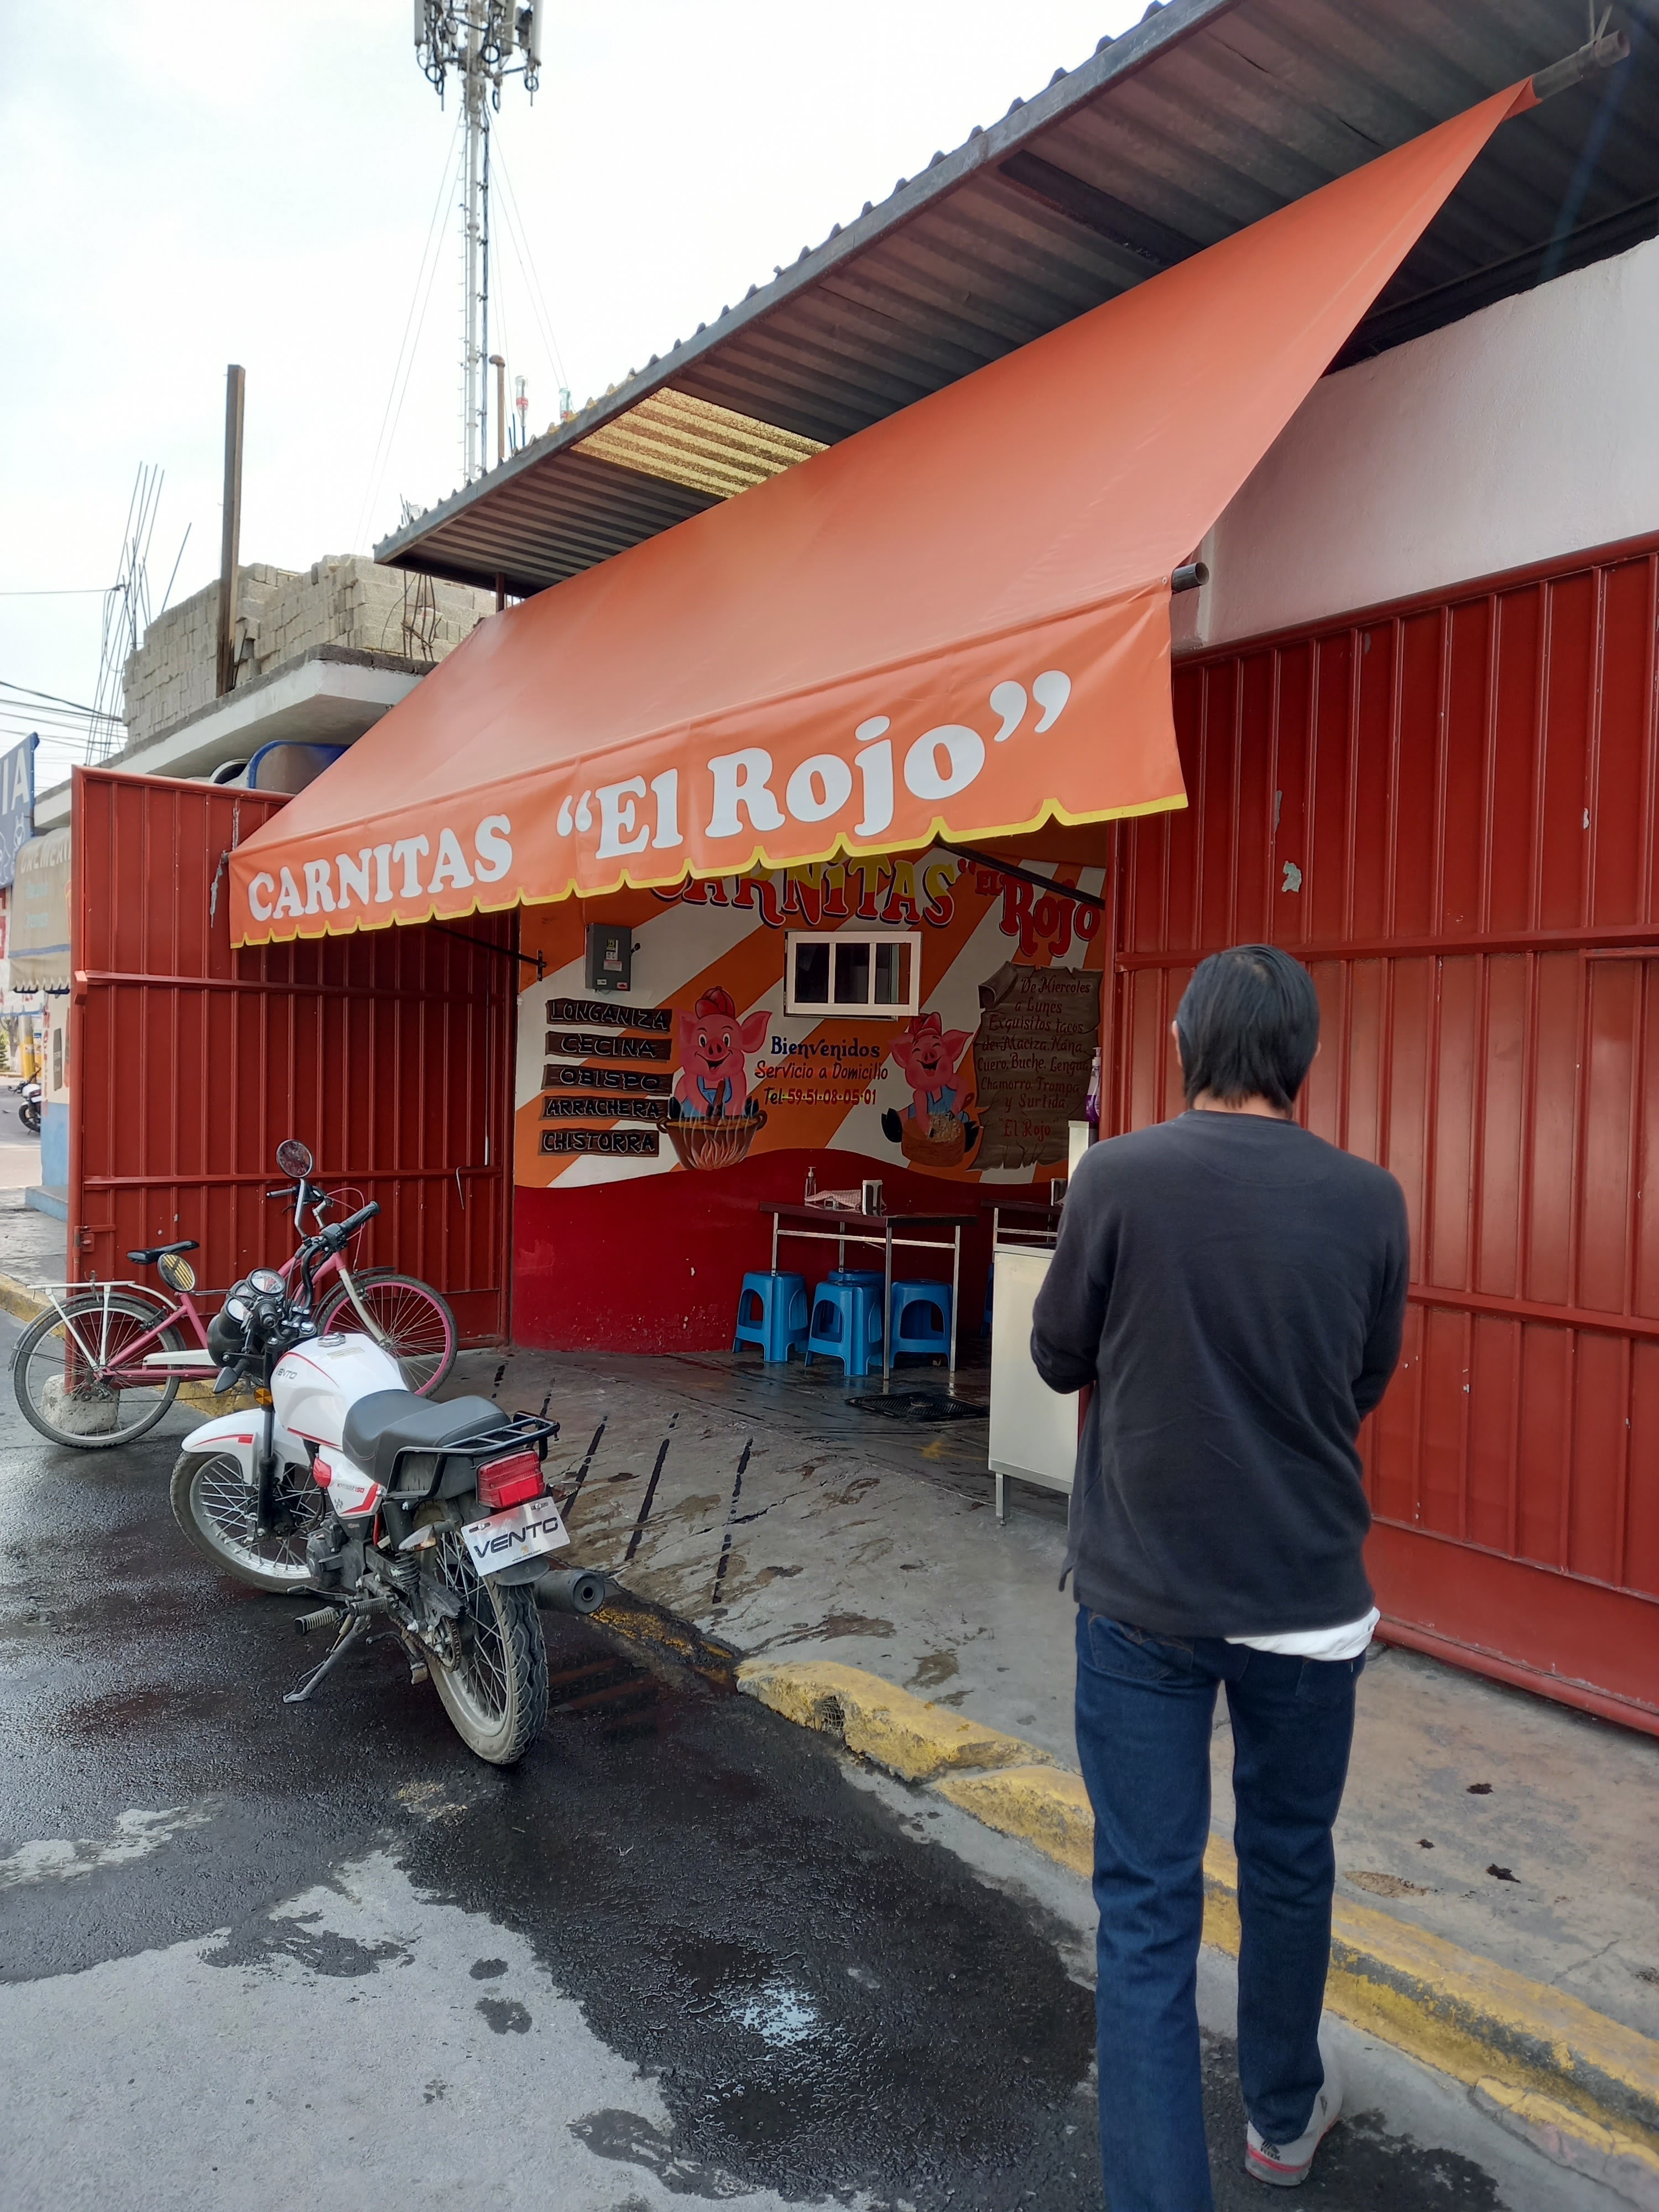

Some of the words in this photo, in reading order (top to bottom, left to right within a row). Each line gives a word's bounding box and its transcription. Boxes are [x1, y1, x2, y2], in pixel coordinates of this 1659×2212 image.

[248, 813, 512, 922] CARNITAS
[1021, 976, 1036, 993] De
[1038, 975, 1091, 993] Miercoles
[551, 1001, 667, 1030] LONGANIZA
[1015, 1002, 1021, 1011] a
[1027, 997, 1062, 1016] Lunes
[1056, 1018, 1083, 1034] tacos
[561, 1034, 657, 1057] CECINA
[771, 1036, 880, 1061] Bienvenidos
[560, 1068, 660, 1091] OBISPO
[755, 1060, 813, 1078] Servicio
[819, 1067, 827, 1078] a
[832, 1062, 888, 1080] Domicilio
[546, 1099, 660, 1118] ARRACHERA
[1005, 1097, 1013, 1113] y
[543, 1133, 655, 1153] CHISTORRA
[474, 1517, 558, 1558] VENTO
